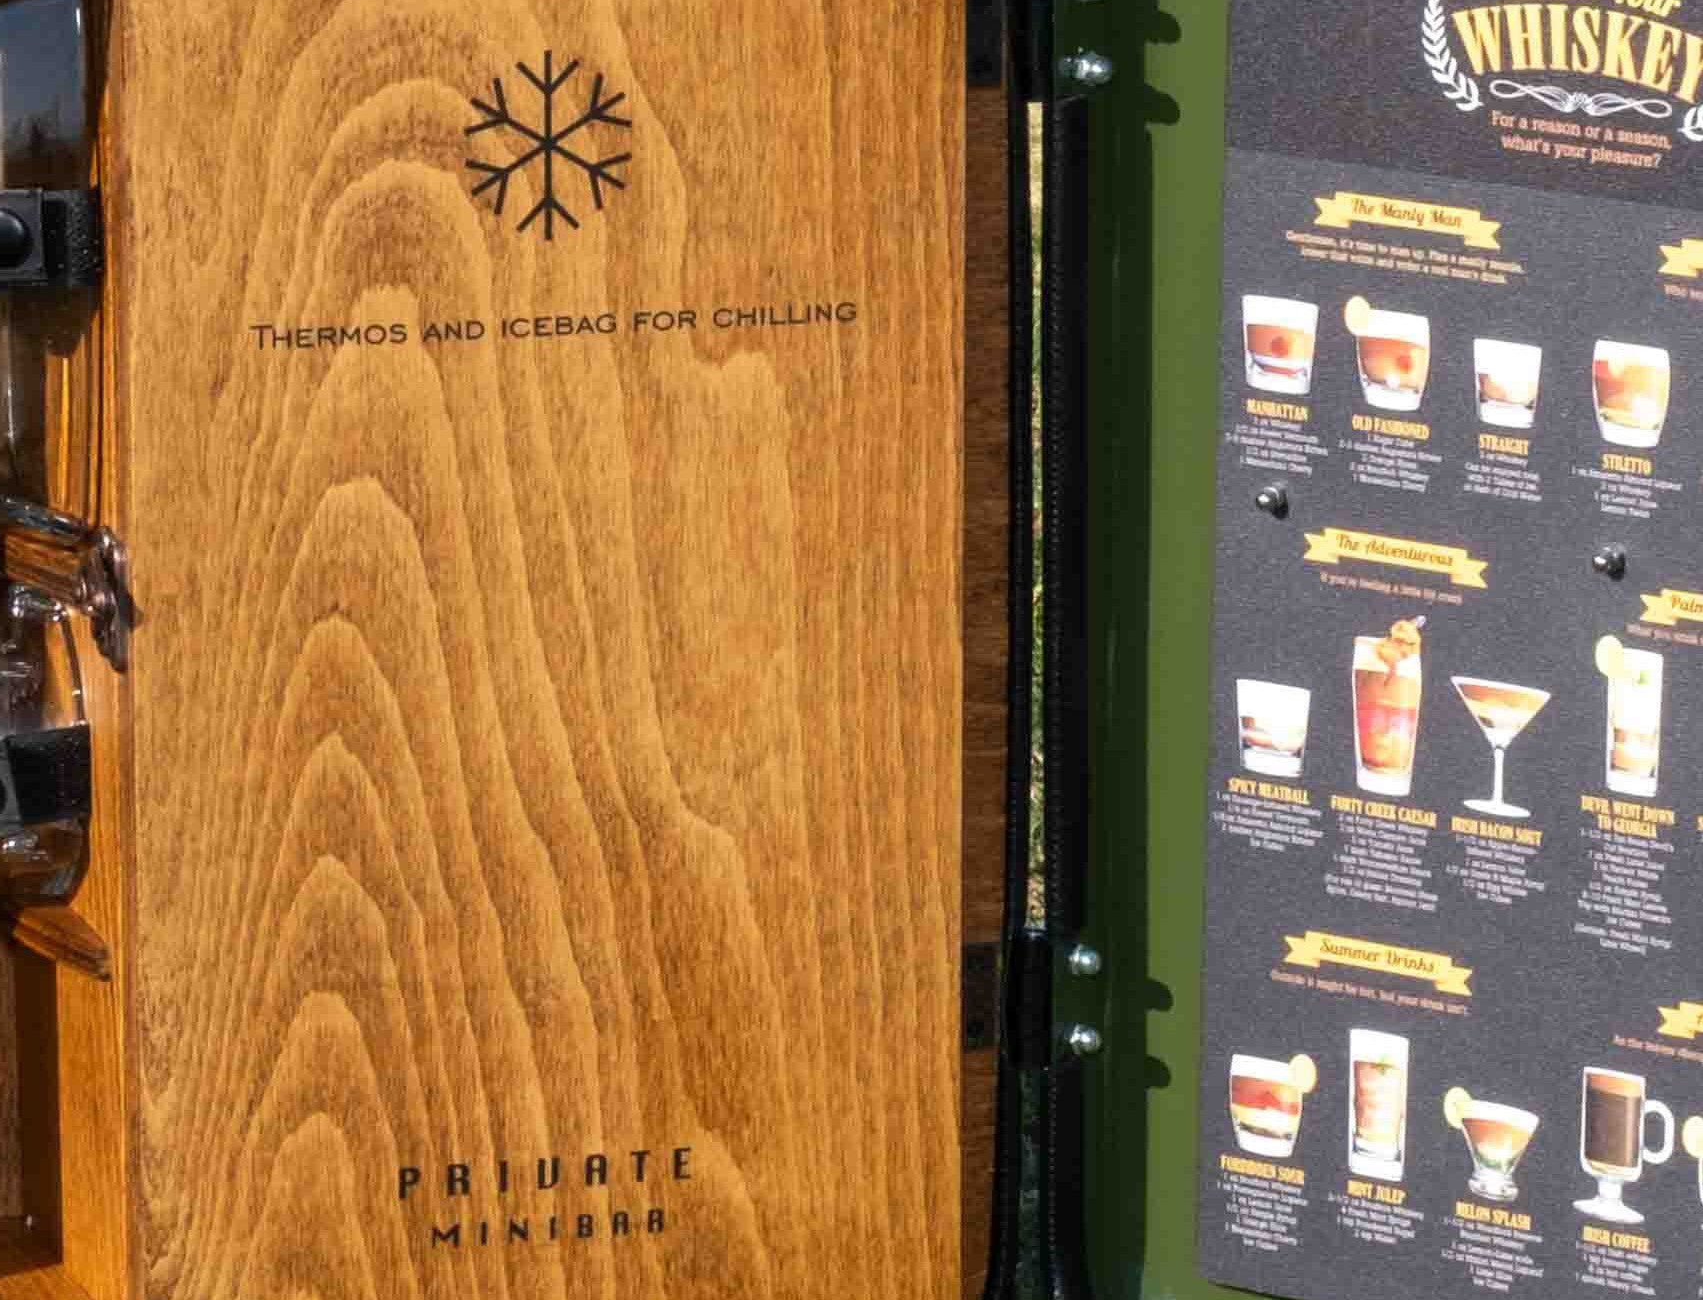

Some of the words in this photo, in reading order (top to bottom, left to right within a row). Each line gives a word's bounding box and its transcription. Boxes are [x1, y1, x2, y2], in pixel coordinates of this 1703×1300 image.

[1491, 110, 1515, 130] For
[1518, 117, 1528, 130] a
[1531, 119, 1581, 138] reason
[1584, 125, 1602, 139] or
[1501, 134, 1551, 156] what's
[1553, 143, 1588, 161] your
[1591, 145, 1662, 169] pleasure?
[1351, 197, 1374, 216] The
[1381, 204, 1425, 226] Manly
[1431, 212, 1462, 229] Man
[250, 323, 407, 351] THERMOS
[422, 319, 485, 343] AND
[501, 313, 617, 339] ICEBAG
[633, 308, 697, 332] FOR
[712, 301, 857, 330] CHILLING
[1351, 414, 1373, 432] OLD
[1602, 453, 1652, 476] STILETTO
[1335, 533, 1359, 551] The
[1365, 541, 1454, 567] Adventurous
[1319, 937, 1380, 963] Summer
[1385, 949, 1435, 974] Drinks
[398, 1146, 692, 1200] PRIVATE
[430, 1208, 665, 1250] MINIBAR
